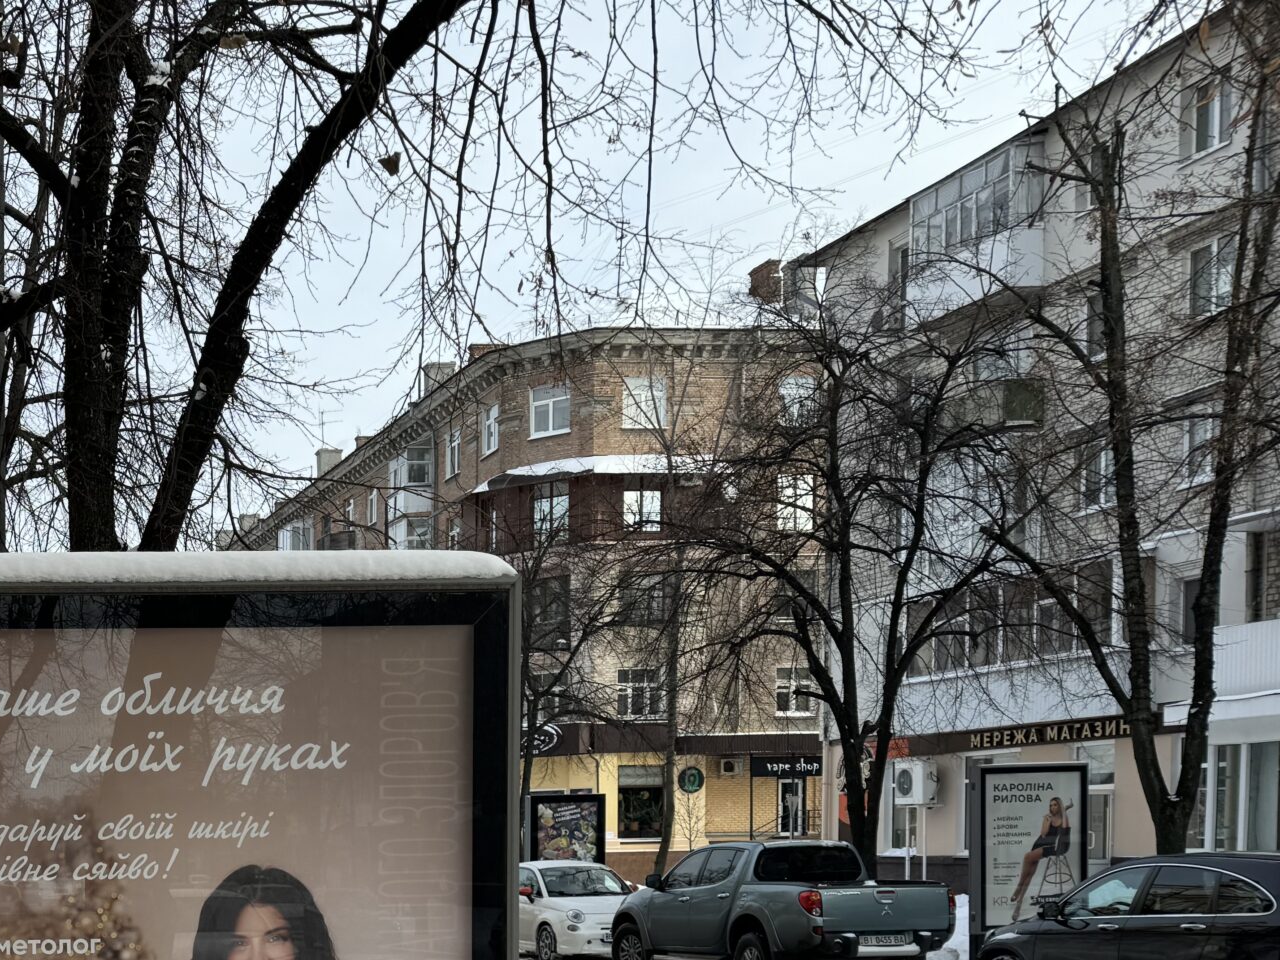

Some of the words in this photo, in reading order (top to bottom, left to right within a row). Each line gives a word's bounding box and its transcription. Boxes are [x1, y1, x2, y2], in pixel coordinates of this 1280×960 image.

[100, 672, 285, 715] обличчя
[970, 727, 1038, 748] МЕРЕЖА
[1046, 719, 1131, 741] МАГАЗИН
[24, 745, 53, 789] у
[70, 731, 184, 773] моїх
[201, 737, 351, 787] руках
[766, 762, 791, 775] vape
[795, 758, 820, 775] shop
[993, 782, 1054, 792] КАРОЛІНА
[993, 794, 1042, 803] РИЛОВА
[97, 812, 178, 840] своїй
[187, 811, 274, 848] шкірі
[71, 847, 180, 881] сяйво!
[875, 936, 893, 944] 0455
